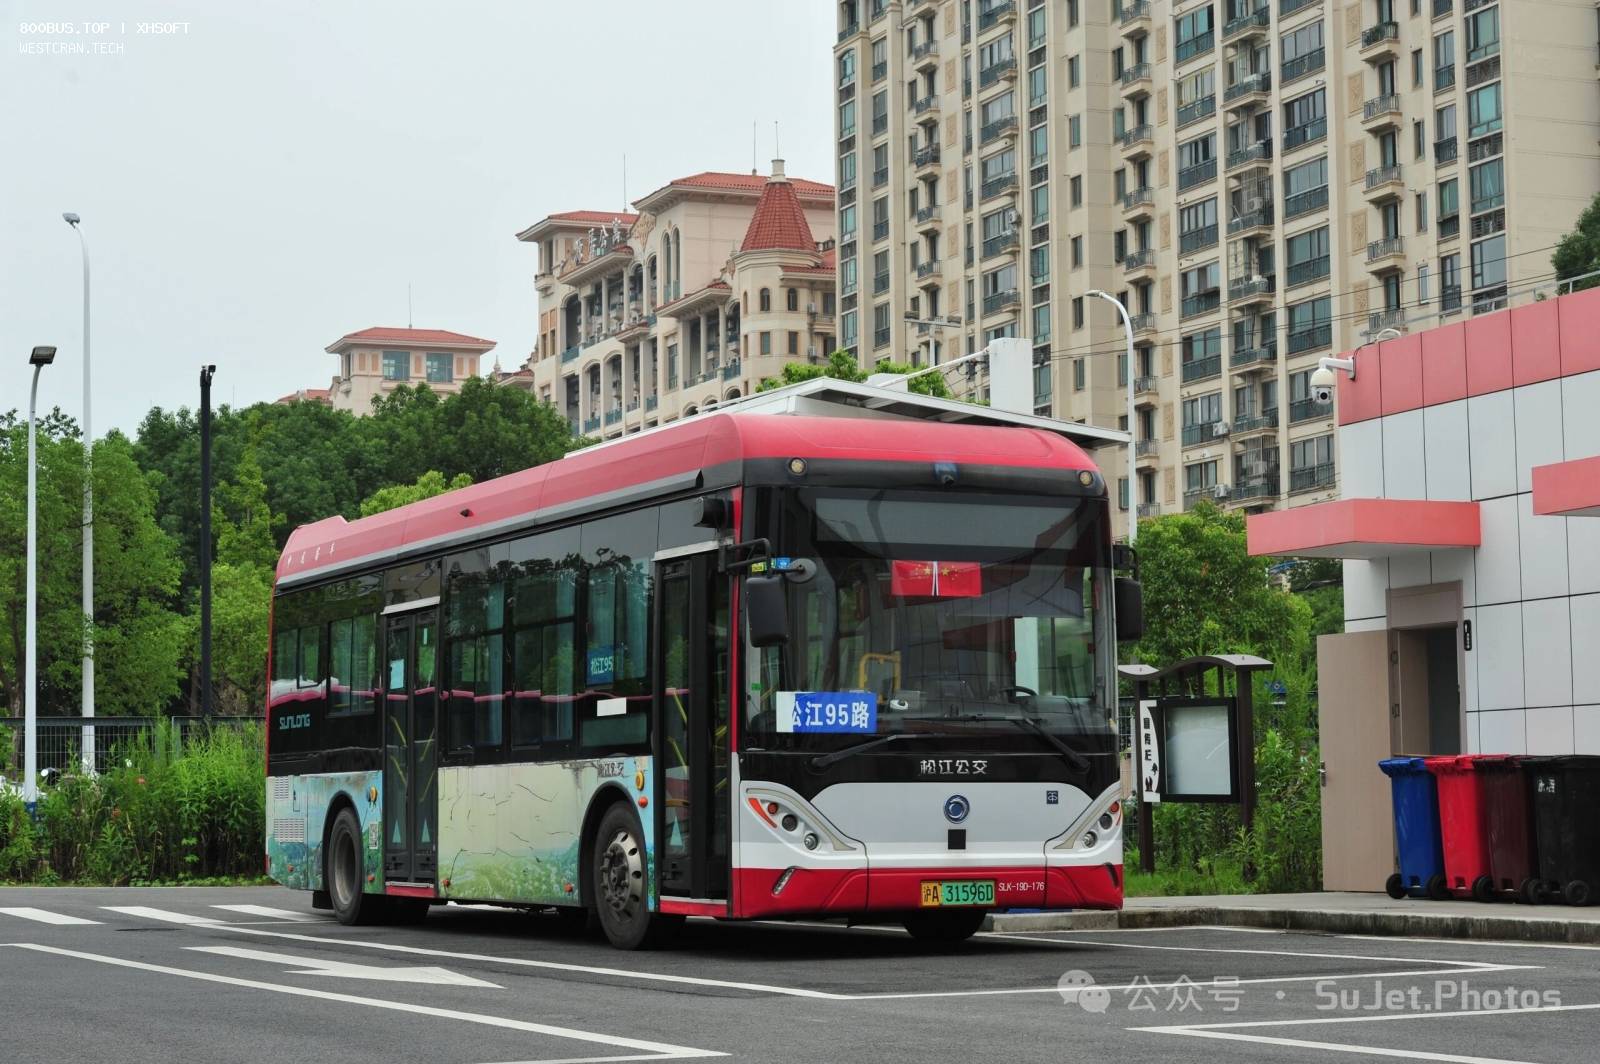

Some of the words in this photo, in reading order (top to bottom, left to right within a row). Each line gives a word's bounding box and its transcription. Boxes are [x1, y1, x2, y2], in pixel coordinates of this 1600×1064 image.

[279, 713, 310, 730] SUNLONG
[920, 760, 988, 774] 松江公交
[945, 883, 993, 902] 31596D
[998, 882, 1045, 892] SLK-19D-176
